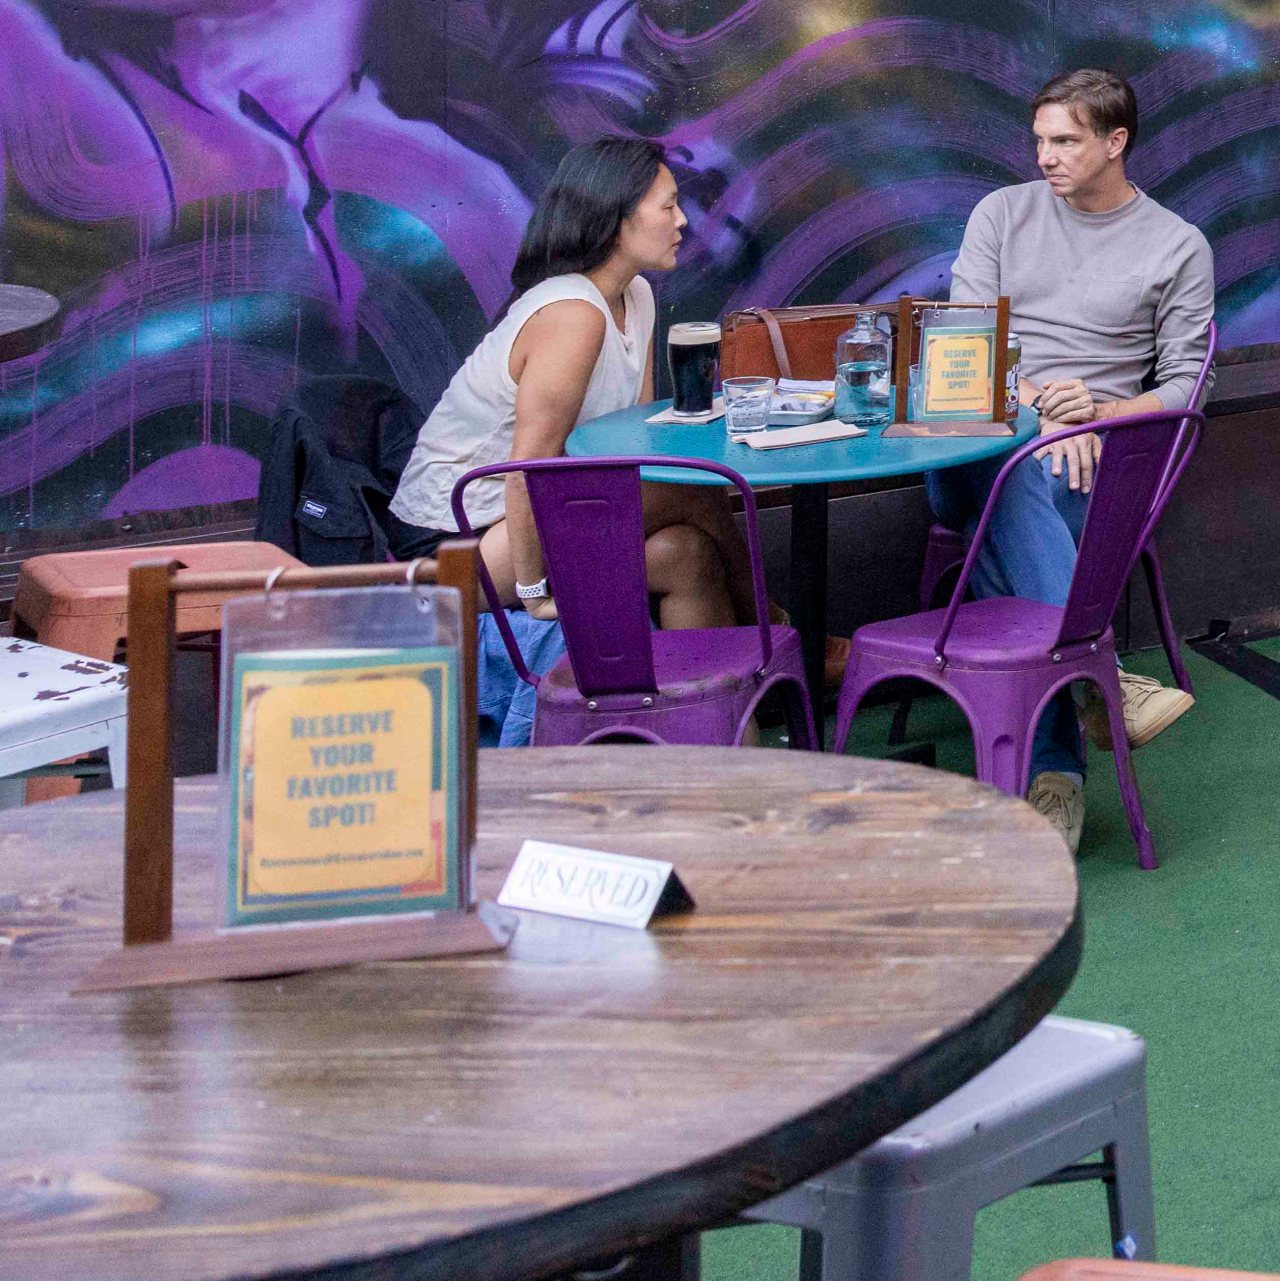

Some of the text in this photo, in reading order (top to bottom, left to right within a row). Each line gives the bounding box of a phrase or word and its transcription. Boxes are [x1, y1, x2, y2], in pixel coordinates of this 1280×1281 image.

[944, 350, 976, 359] RESERVE
[950, 360, 970, 368] YOUR
[942, 370, 977, 379] FAVORITE
[290, 709, 395, 739] RESERVE
[309, 743, 374, 768] YOUR
[286, 770, 397, 800] FAVORITE
[308, 802, 376, 830] SPOT!
[523, 857, 648, 908] RESERVED
